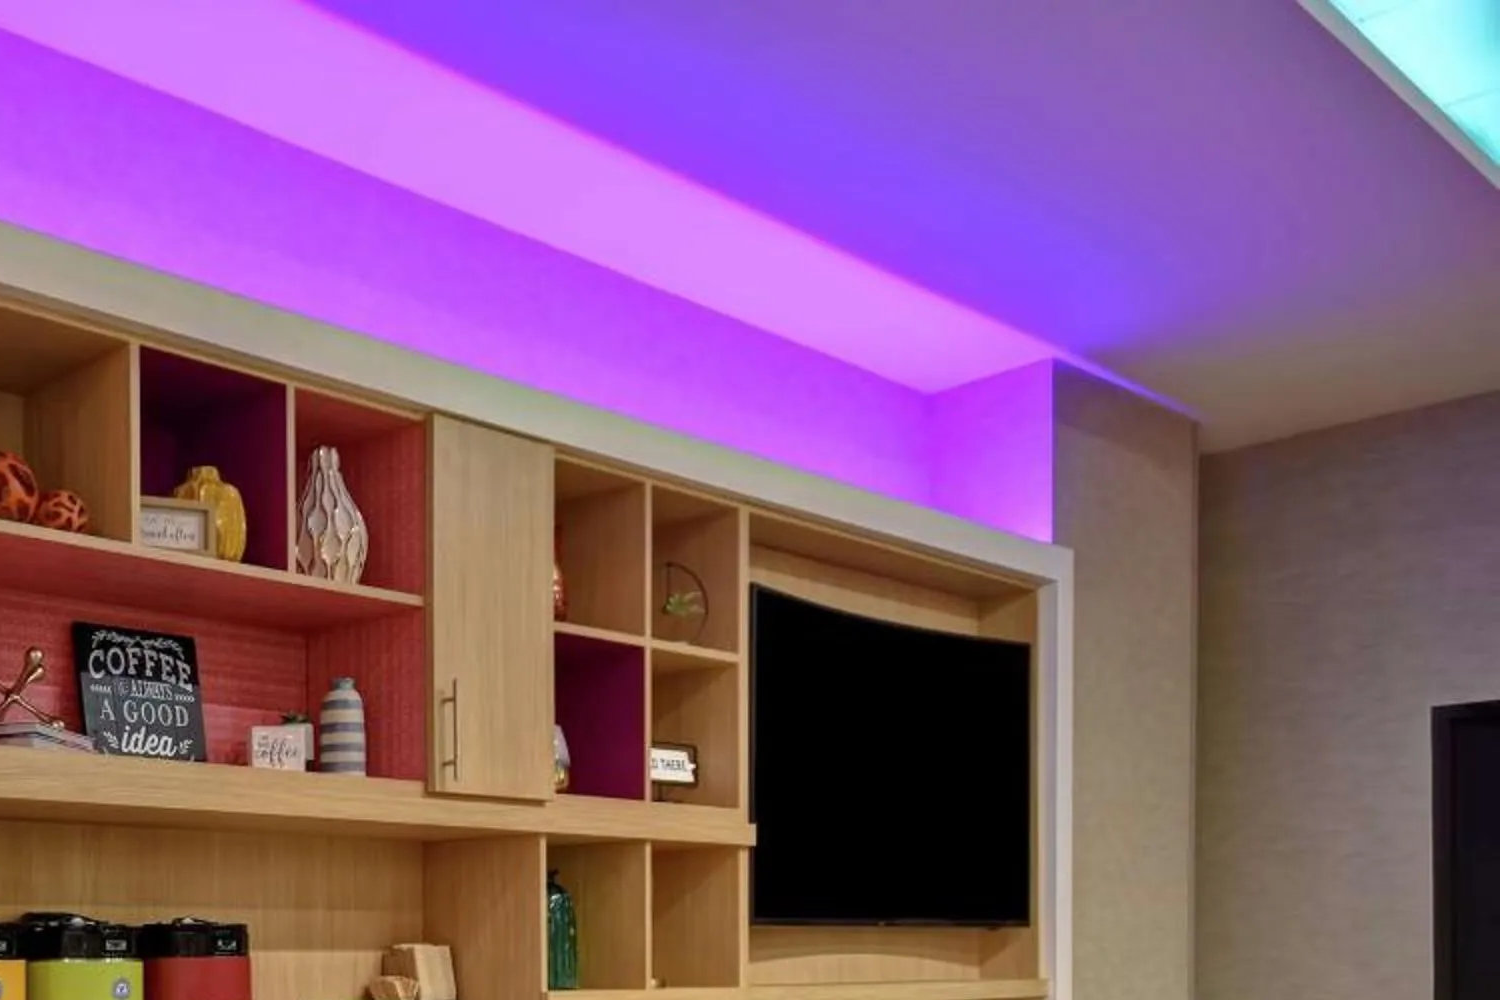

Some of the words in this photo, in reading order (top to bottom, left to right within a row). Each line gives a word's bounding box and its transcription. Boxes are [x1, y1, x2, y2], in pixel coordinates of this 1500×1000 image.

[89, 647, 192, 692] COFFEE
[100, 698, 115, 720] A
[123, 700, 189, 727] GOOD
[121, 725, 177, 756] idea
